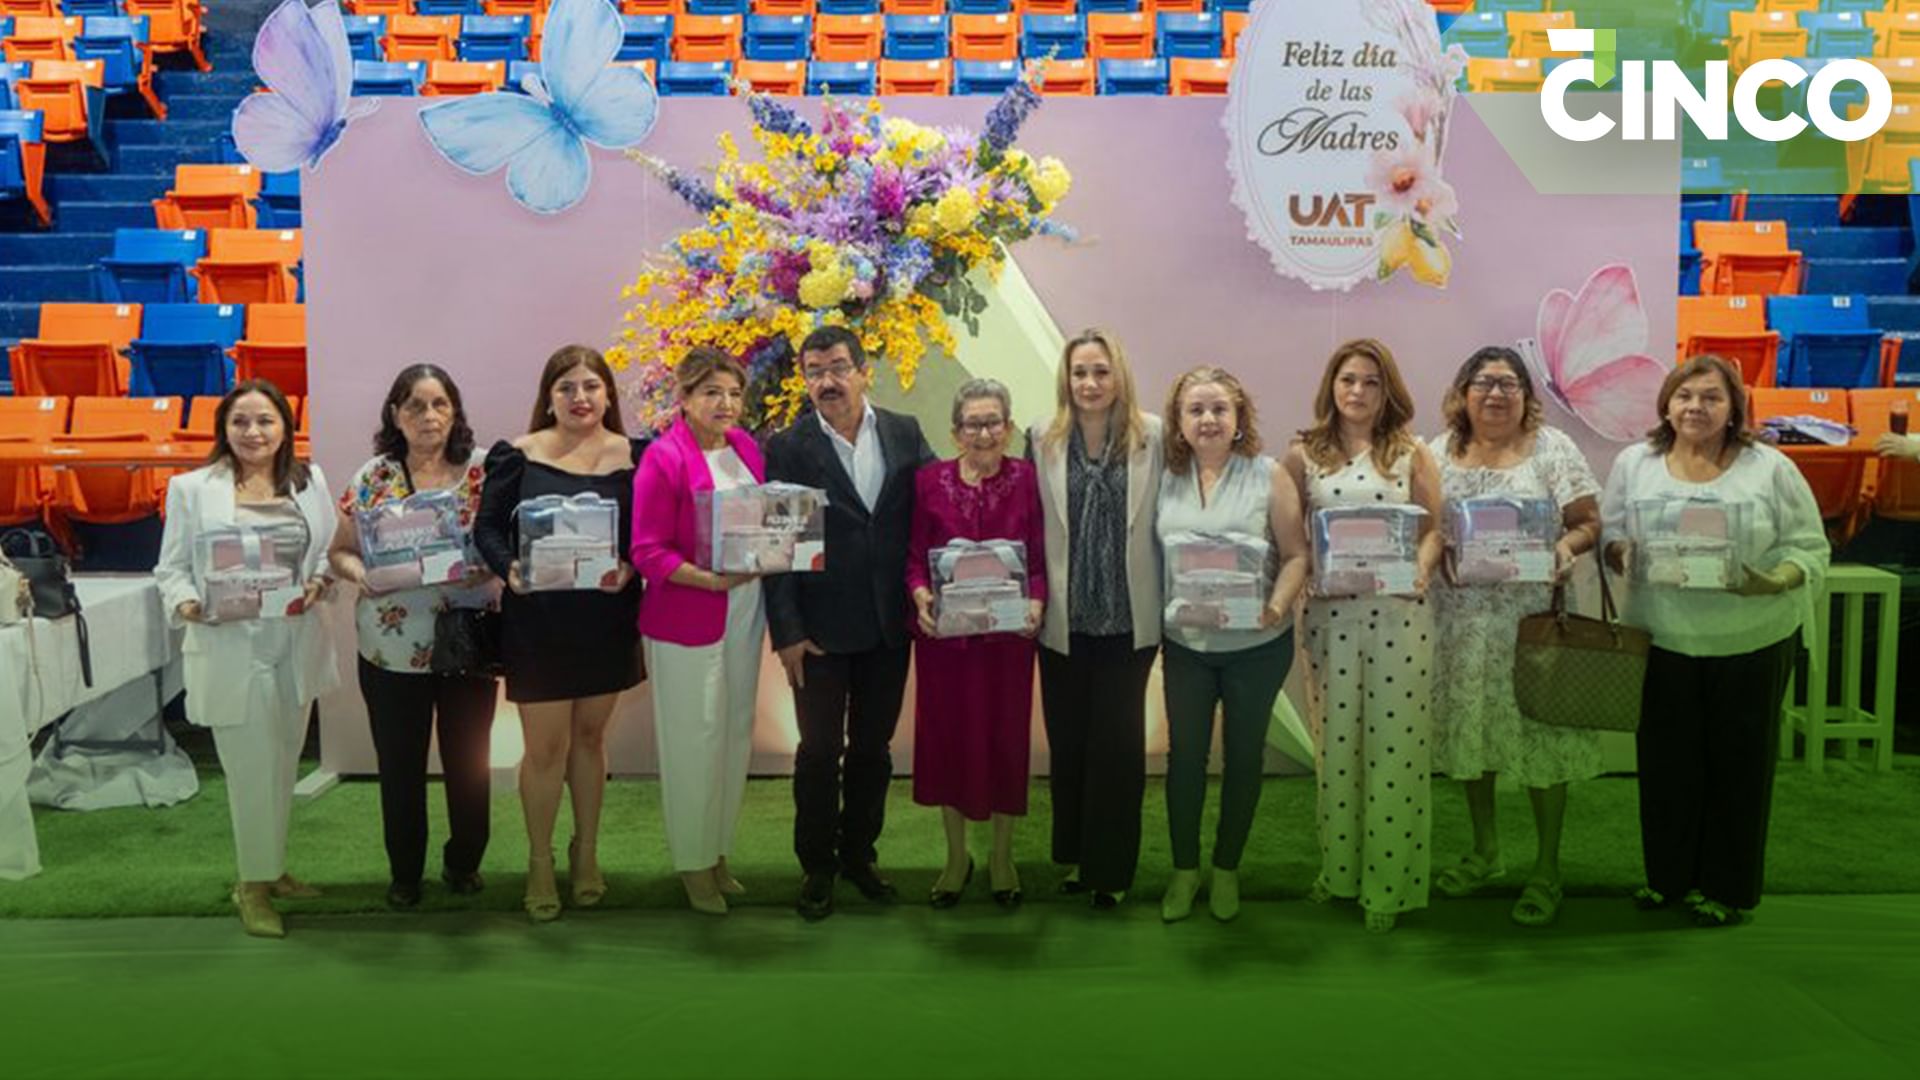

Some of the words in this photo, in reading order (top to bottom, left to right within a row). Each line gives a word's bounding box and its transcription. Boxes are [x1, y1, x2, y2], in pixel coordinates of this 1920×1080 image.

[1282, 41, 1344, 68] Feliz
[1352, 41, 1398, 68] día
[1305, 78, 1333, 101] de
[1339, 78, 1373, 101] las
[1257, 107, 1399, 155] Madres
[1289, 192, 1376, 227] UAT
[1290, 236, 1373, 246] TAMAULIPAS
